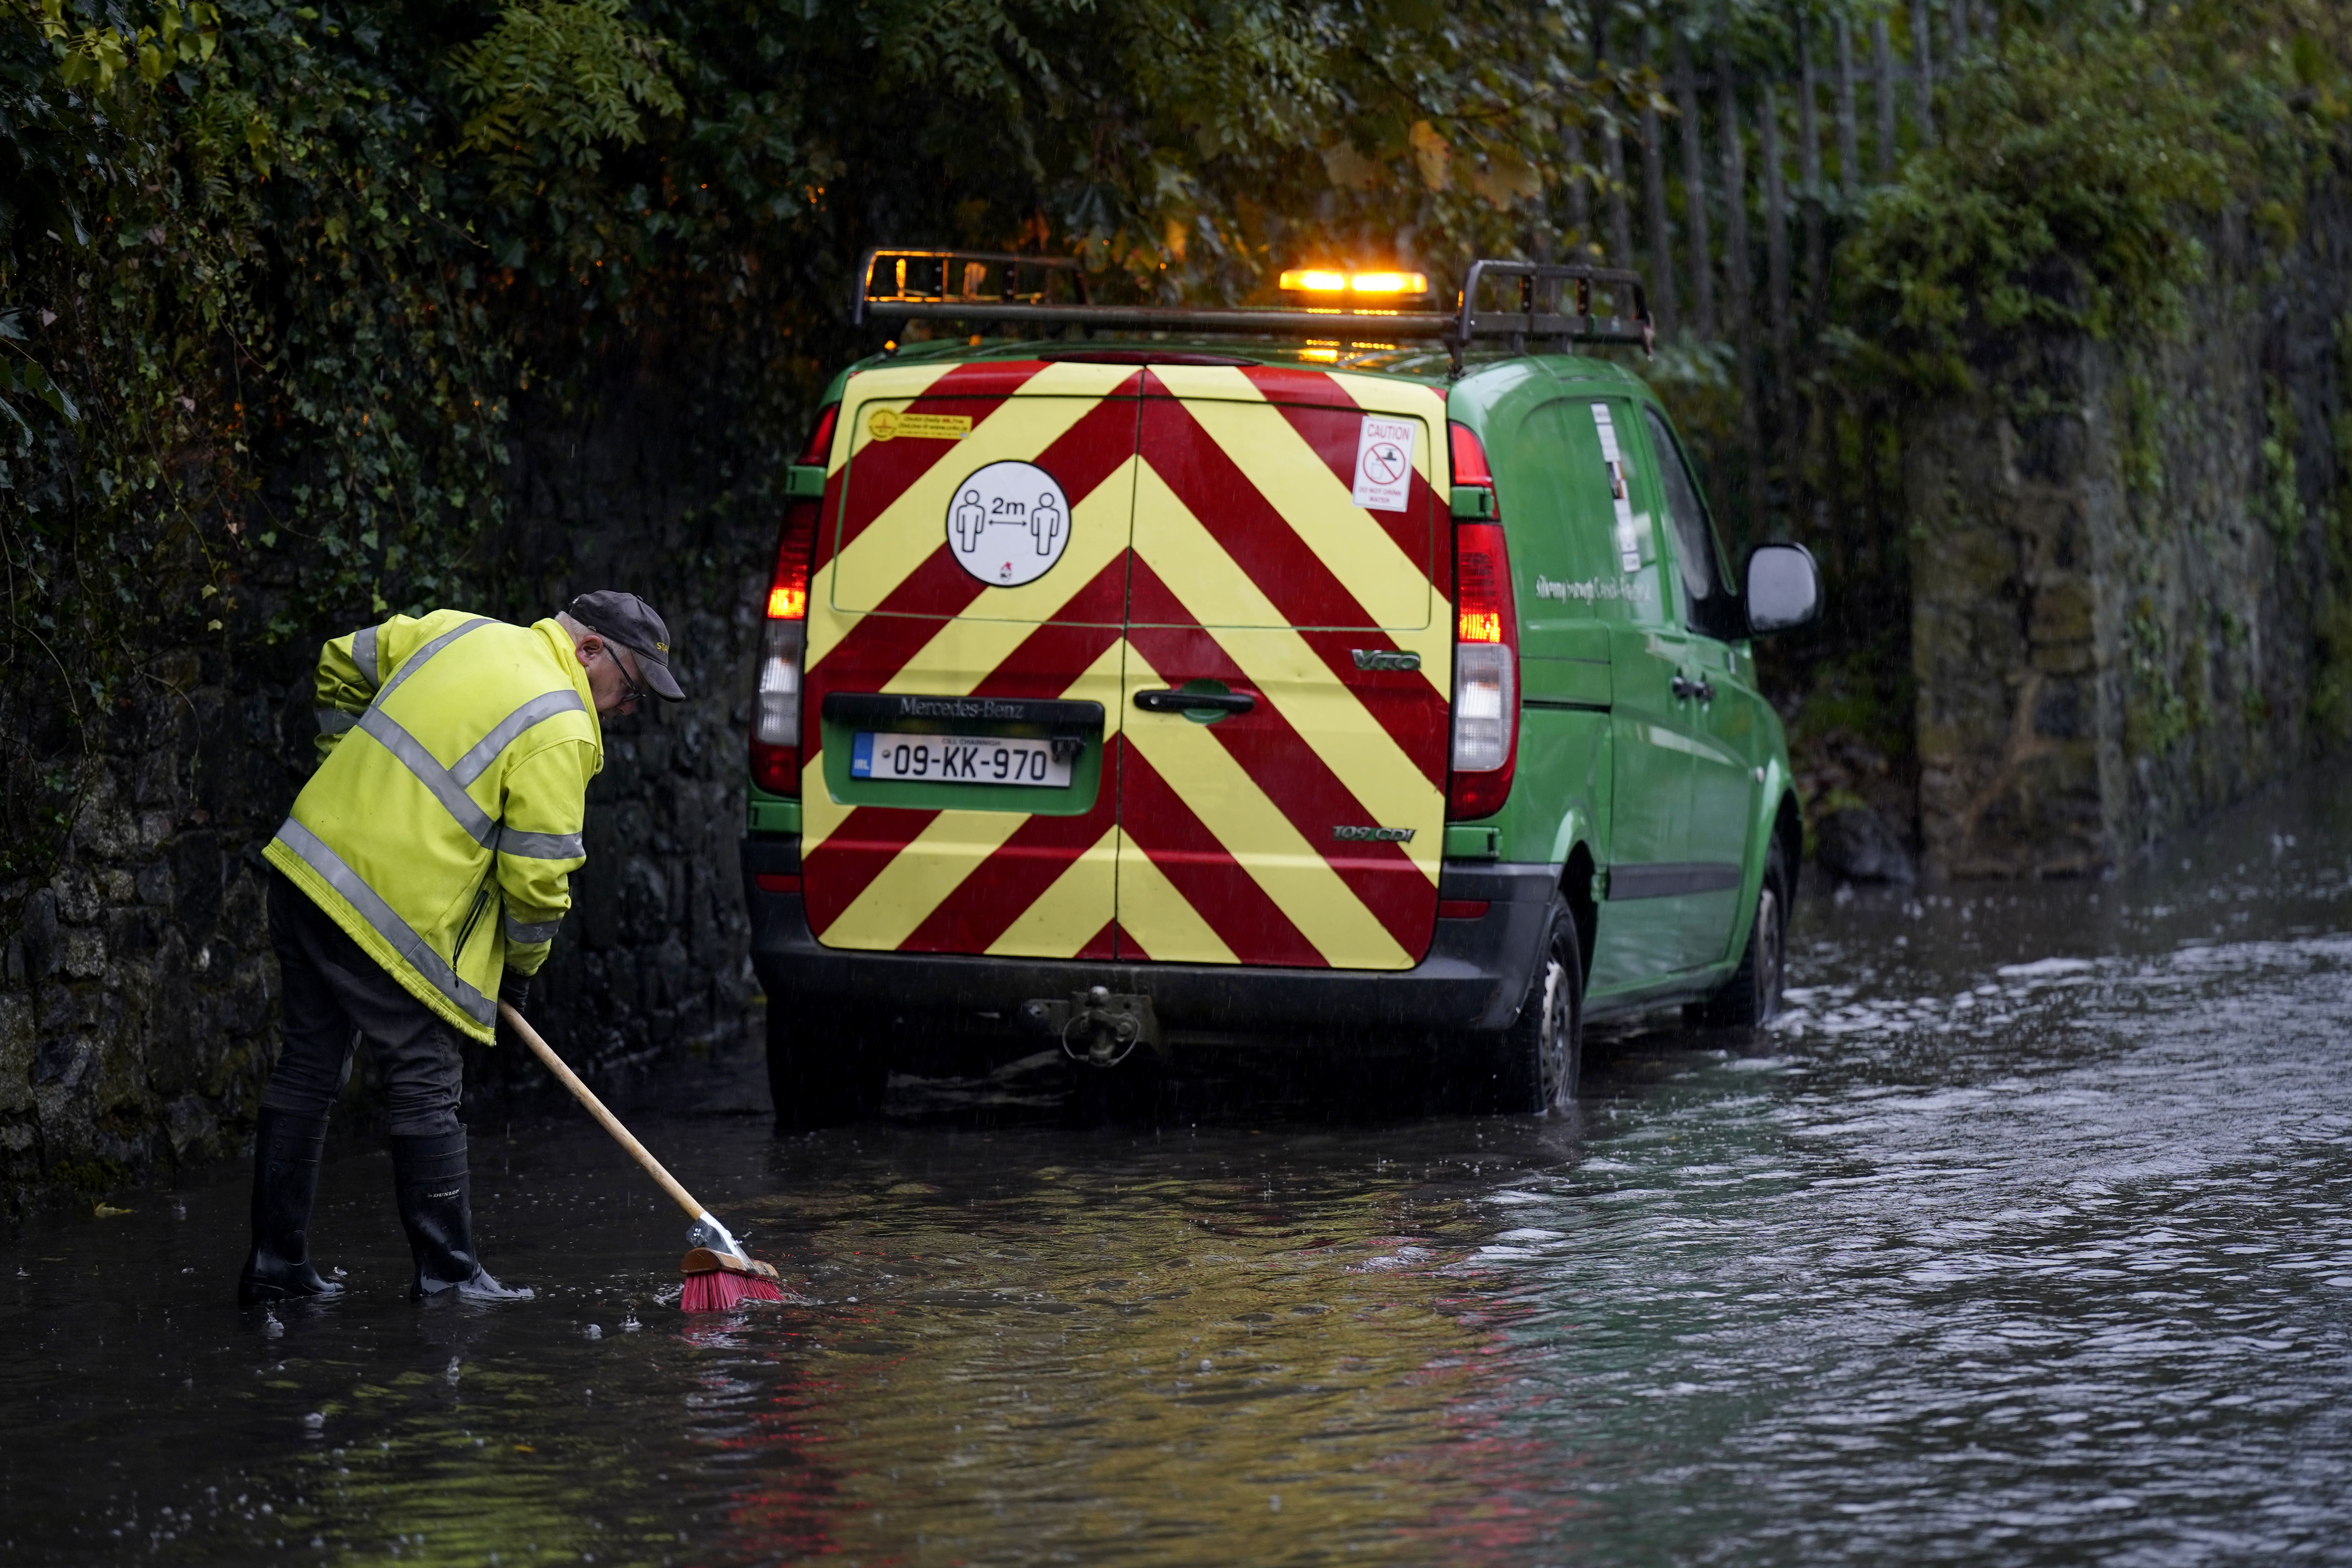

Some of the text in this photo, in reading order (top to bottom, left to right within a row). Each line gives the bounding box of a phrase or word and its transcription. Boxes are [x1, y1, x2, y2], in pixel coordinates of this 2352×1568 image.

[1367, 423, 1410, 441] CAUTION
[992, 498, 1025, 515] 2m
[656, 642, 669, 653] STA
[900, 697, 1024, 719] Mercedes-Benz
[854, 759, 869, 770] IRL
[894, 744, 1046, 781] 09-KK-970
[1333, 825, 1415, 842] 109 CDI
[433, 1189, 460, 1197] DUNLOP
